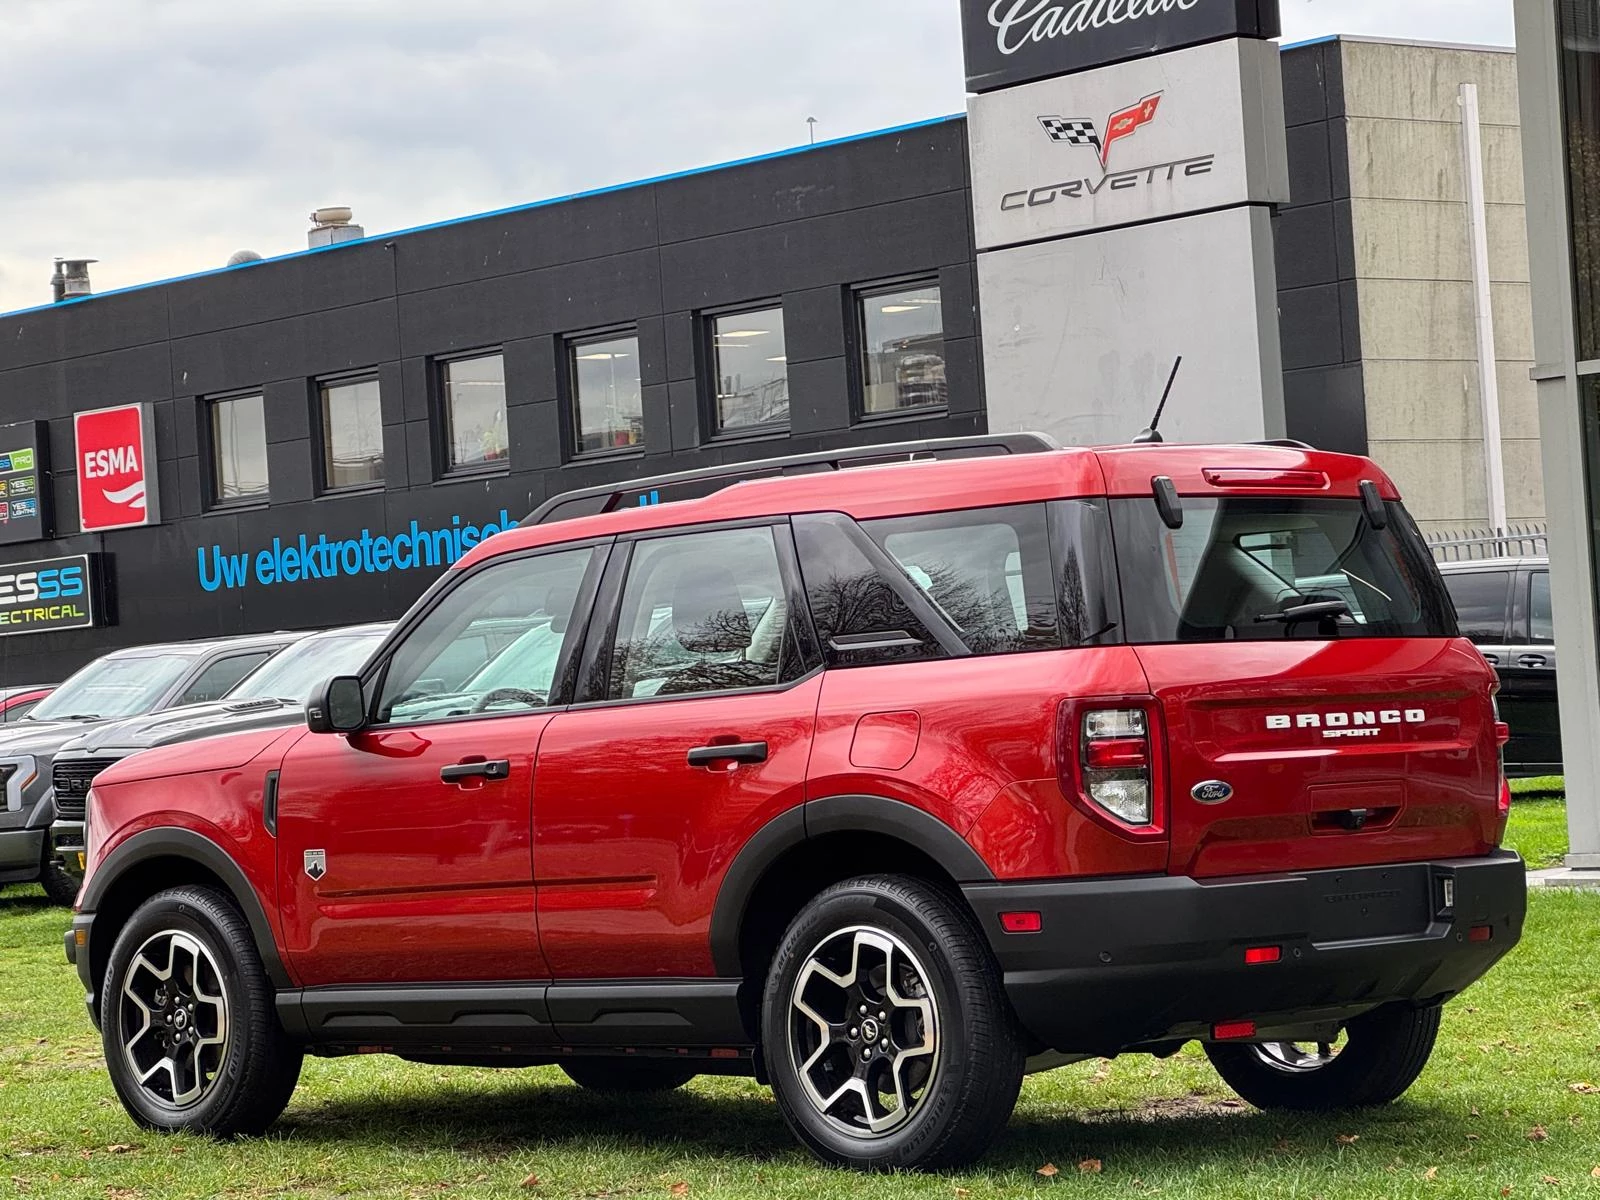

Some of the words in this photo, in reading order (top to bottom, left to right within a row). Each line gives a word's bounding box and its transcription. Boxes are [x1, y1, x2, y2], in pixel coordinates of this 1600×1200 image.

[1000, 154, 1215, 211] CORVETTE
[14, 455, 32, 466] PRO
[84, 445, 139, 479] ESMA
[197, 545, 249, 592] Uw
[0, 566, 83, 605] ESSS
[0, 604, 85, 625] ECTRICAL
[1265, 708, 1426, 729] BRONCO
[1322, 727, 1381, 738] SPORT
[70, 779, 92, 790] RA
[1201, 784, 1225, 798] Ford
